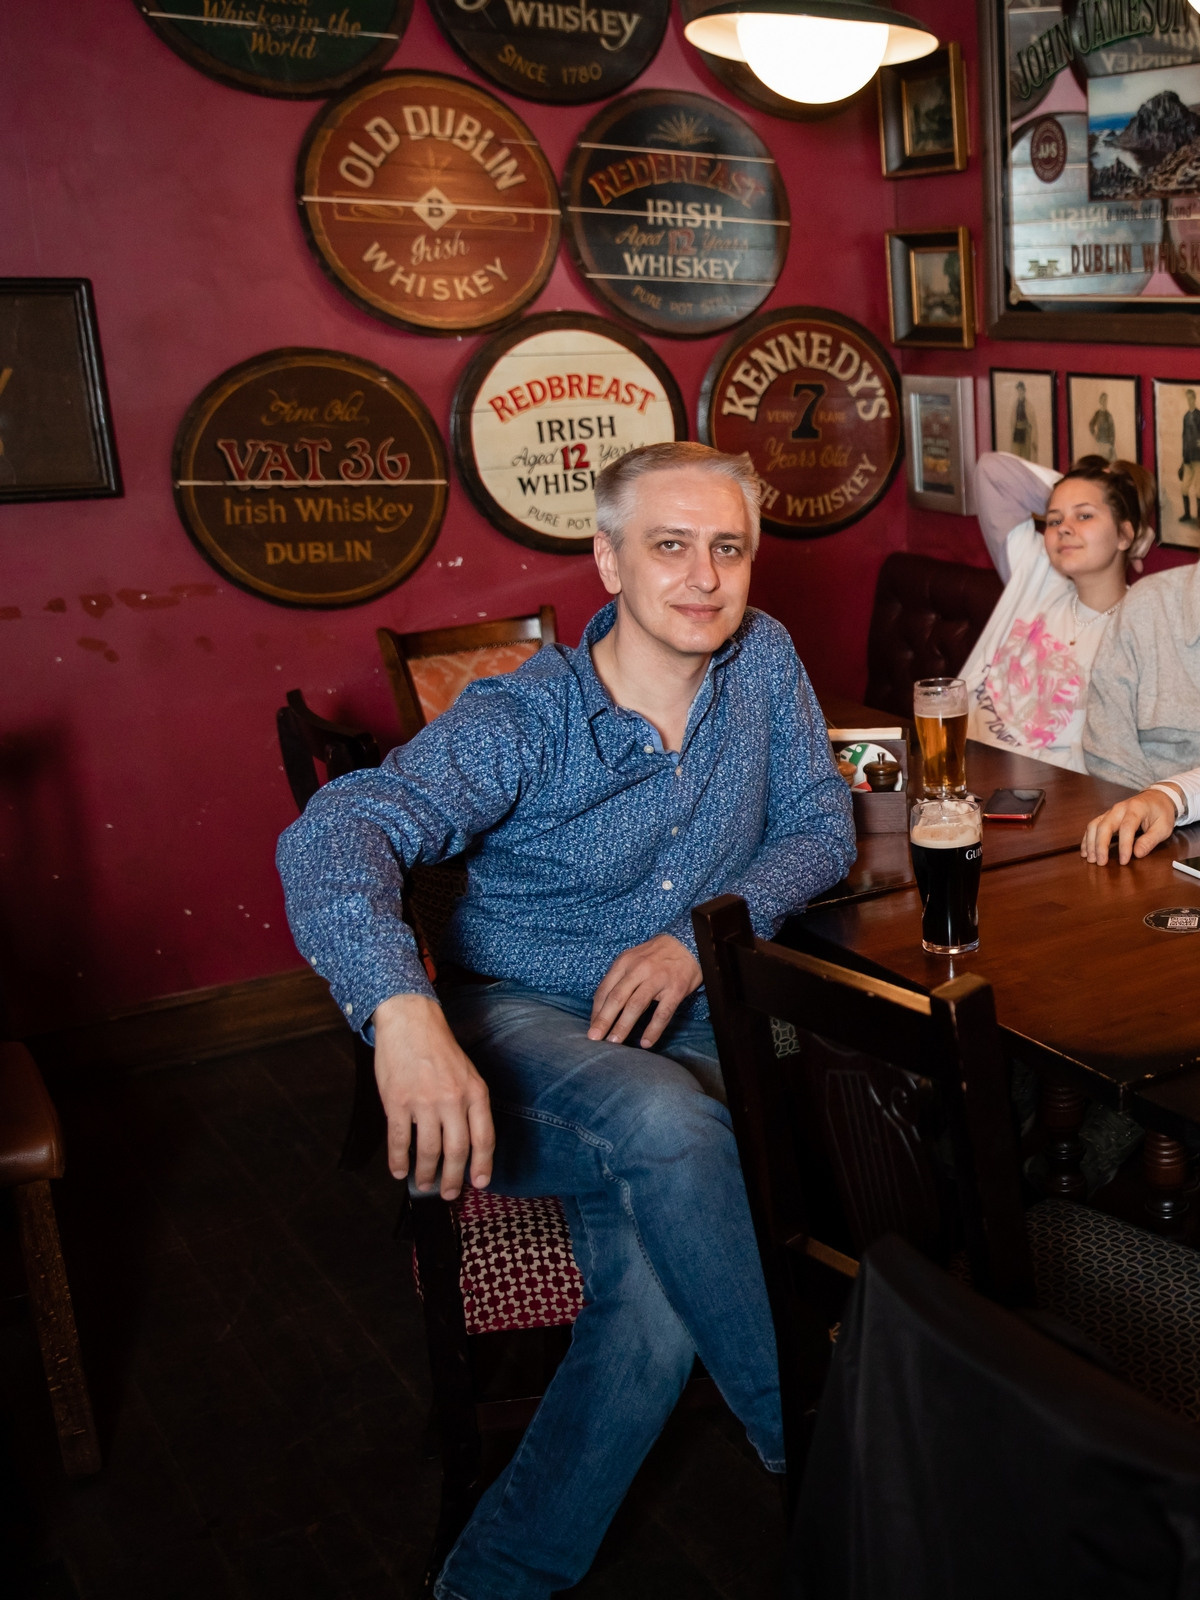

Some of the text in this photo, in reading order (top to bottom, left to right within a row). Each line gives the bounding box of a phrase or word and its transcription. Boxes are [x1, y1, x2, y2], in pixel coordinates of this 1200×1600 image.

[328, 9, 362, 38] the
[505, 0, 641, 51] WHISKEY
[251, 31, 318, 59] World
[1016, 16, 1074, 99] JOHN
[1079, 0, 1193, 54] JAMESON
[498, 44, 602, 84] SINCE 1780
[338, 105, 527, 191] OLD DUBLIN
[588, 153, 767, 209] REDBREAST
[646, 199, 724, 230] IRISH
[411, 230, 470, 265] Irish
[615, 224, 666, 253] Aged
[362, 242, 508, 301] WHISKEY
[622, 252, 740, 281] WHISKEY
[1071, 243, 1132, 274] DUBLIN
[722, 331, 891, 422] KENNEDY'S
[261, 388, 370, 425] Fine Old
[488, 374, 656, 424] REDBREAST
[790, 381, 827, 442] 7
[536, 415, 617, 444] IRISH
[217, 437, 411, 491] VAT 36
[511, 446, 559, 474] Aged
[560, 443, 591, 471] 12
[517, 471, 596, 497] WHIS
[786, 454, 878, 518] WHISKEY
[223, 495, 414, 533] Irish Whiskey
[528, 505, 592, 530] PURE POT
[265, 540, 372, 565] DUBLIN
